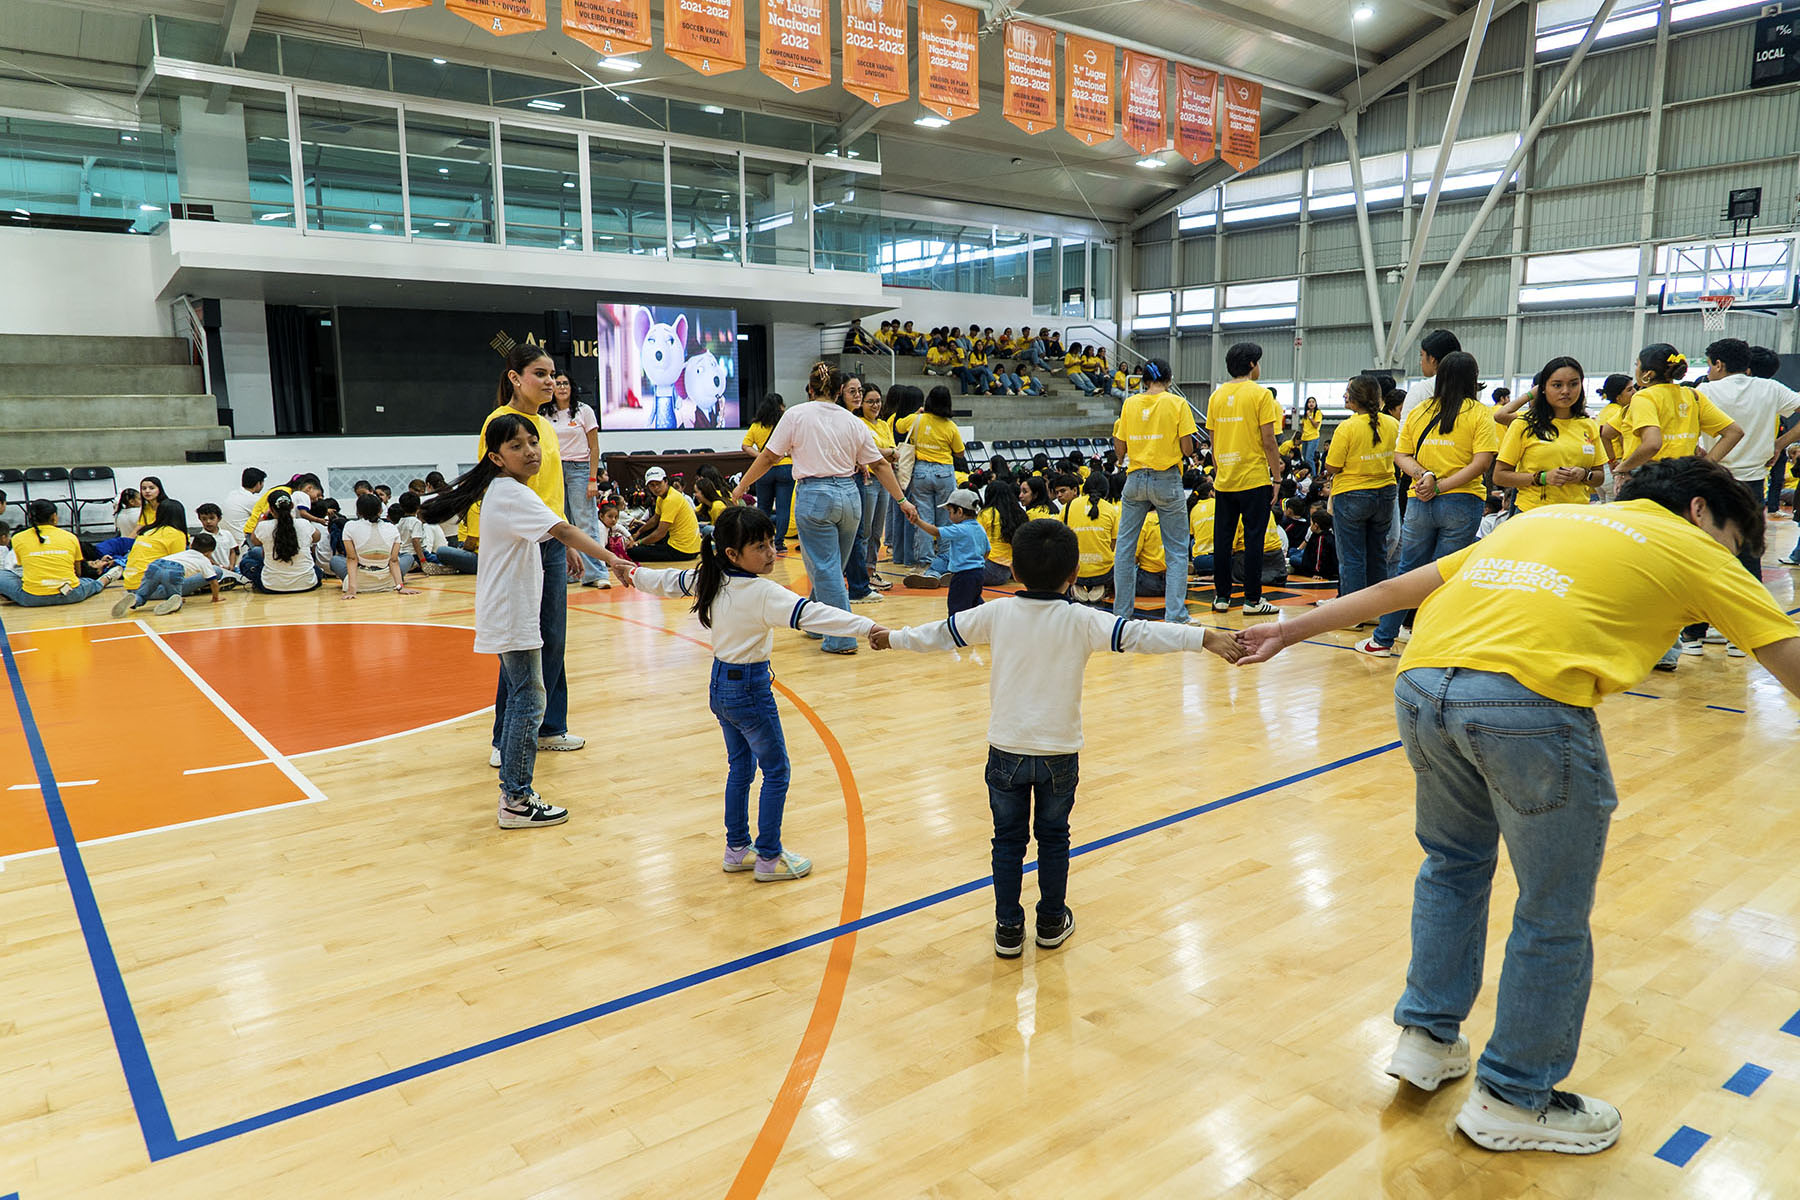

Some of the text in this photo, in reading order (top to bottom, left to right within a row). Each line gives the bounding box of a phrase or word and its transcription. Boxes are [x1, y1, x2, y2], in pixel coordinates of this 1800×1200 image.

[574, 1, 605, 13] NACIONAL
[607, 7, 615, 15] DE
[680, 0, 729, 19] 2021-2022
[786, 0, 822, 18] Lugar
[492, 17, 504, 31] A
[579, 10, 634, 28] VOLEIBOL FEMENIL
[682, 22, 704, 32] SOCCER
[768, 12, 822, 35] Nacional
[847, 15, 904, 39] Final Four
[603, 39, 613, 52] A
[781, 33, 810, 50] 2022
[846, 32, 905, 55] 2022-2023
[922, 31, 976, 52] Subcampeones
[766, 48, 824, 66] CAMPEONATO NACIONAL
[928, 44, 970, 61] Nacionales
[1007, 48, 1052, 67] Campeones
[1756, 47, 1785, 63] LOCAL
[702, 59, 712, 71] A
[857, 59, 876, 69] SOCCER
[930, 55, 968, 72] 2022-2023
[1008, 61, 1051, 79] Nacionales
[792, 75, 801, 88] A
[1085, 66, 1107, 80] Lugar
[1010, 75, 1050, 92] 2022-2023
[1074, 77, 1106, 92] Nacional
[872, 92, 881, 103] A
[1072, 88, 1109, 105] 2022-2023
[1130, 92, 1159, 108] Nacional
[1193, 91, 1211, 104] Lugar
[946, 106, 953, 117] A
[1128, 103, 1162, 120] 2023-2024
[1182, 101, 1211, 115] Nacional
[1027, 120, 1034, 131] A
[1180, 111, 1213, 127] 2023-2024
[1471, 557, 1574, 584] ANAHUAC
[1462, 569, 1569, 599] VERACRUZ
